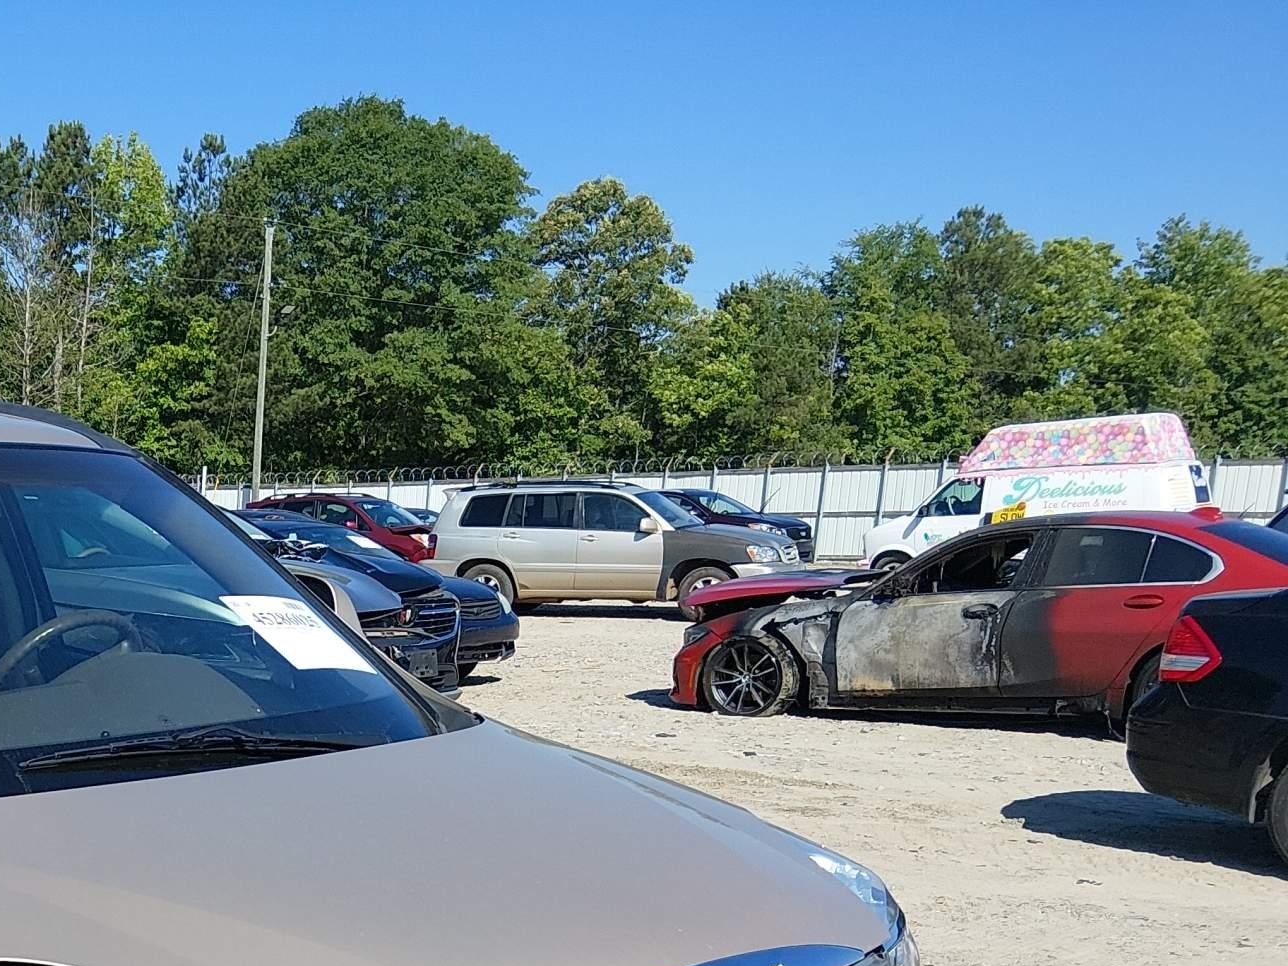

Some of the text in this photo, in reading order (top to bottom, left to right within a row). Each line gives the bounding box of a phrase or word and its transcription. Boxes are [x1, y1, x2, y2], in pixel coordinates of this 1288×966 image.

[1002, 476, 1128, 505] Deelicious
[1043, 498, 1128, 509] Ice Cream & More
